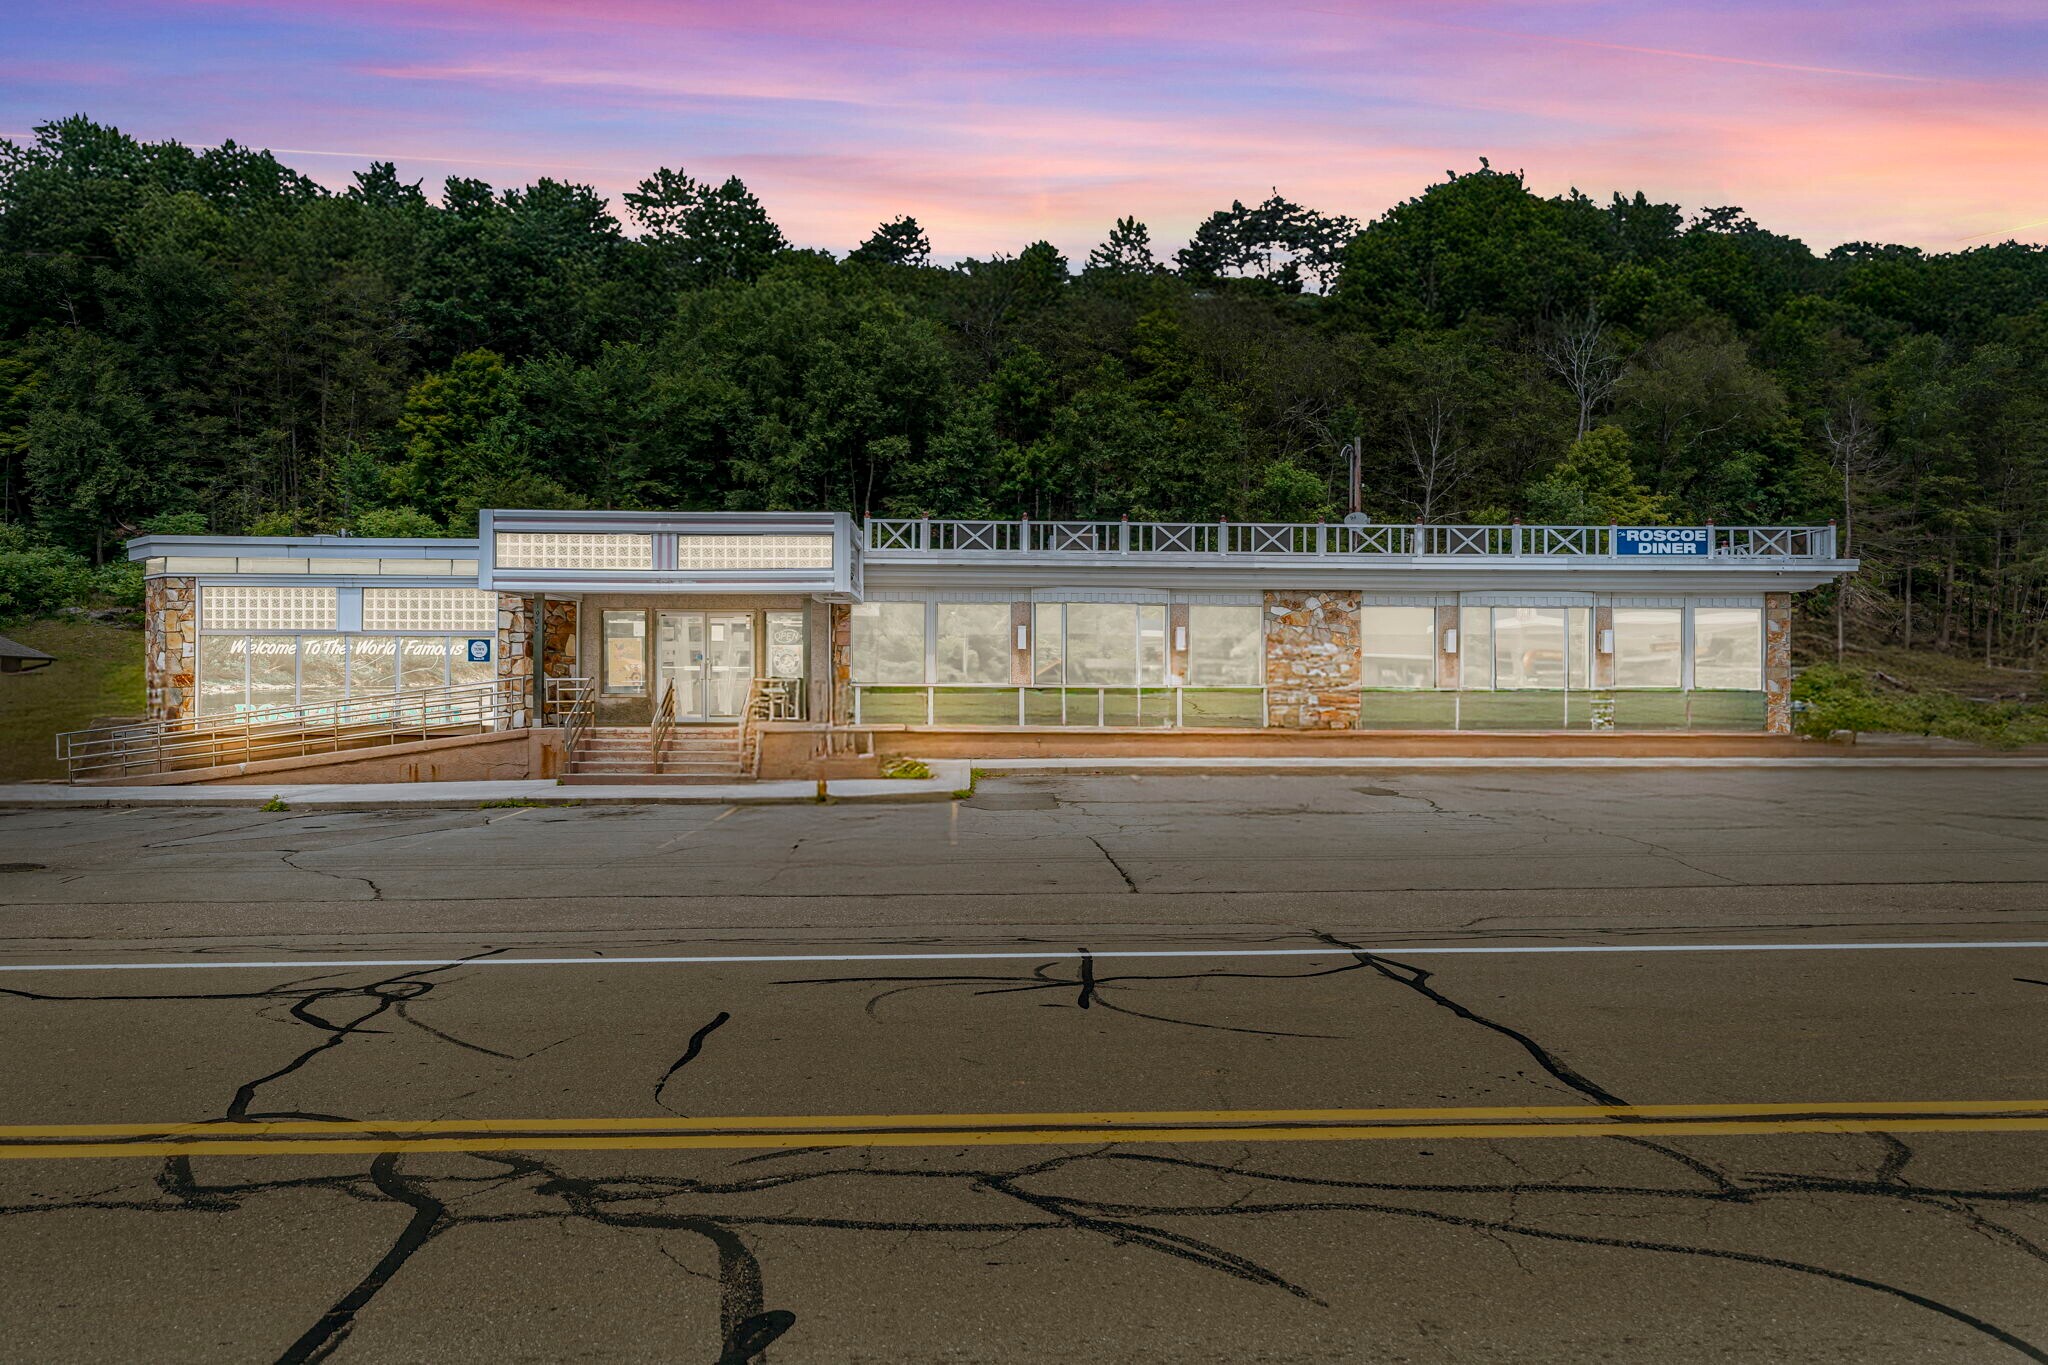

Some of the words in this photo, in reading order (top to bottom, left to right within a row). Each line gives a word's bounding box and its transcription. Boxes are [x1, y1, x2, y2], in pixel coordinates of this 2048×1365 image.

[1627, 530, 1706, 542] ROSCOE
[1638, 543, 1697, 554] DINER
[774, 631, 799, 641] OPEN
[230, 639, 297, 655] Welcome
[304, 640, 321, 655] To
[323, 639, 353, 656] The
[355, 639, 404, 655] World
[404, 640, 465, 656] Famous
